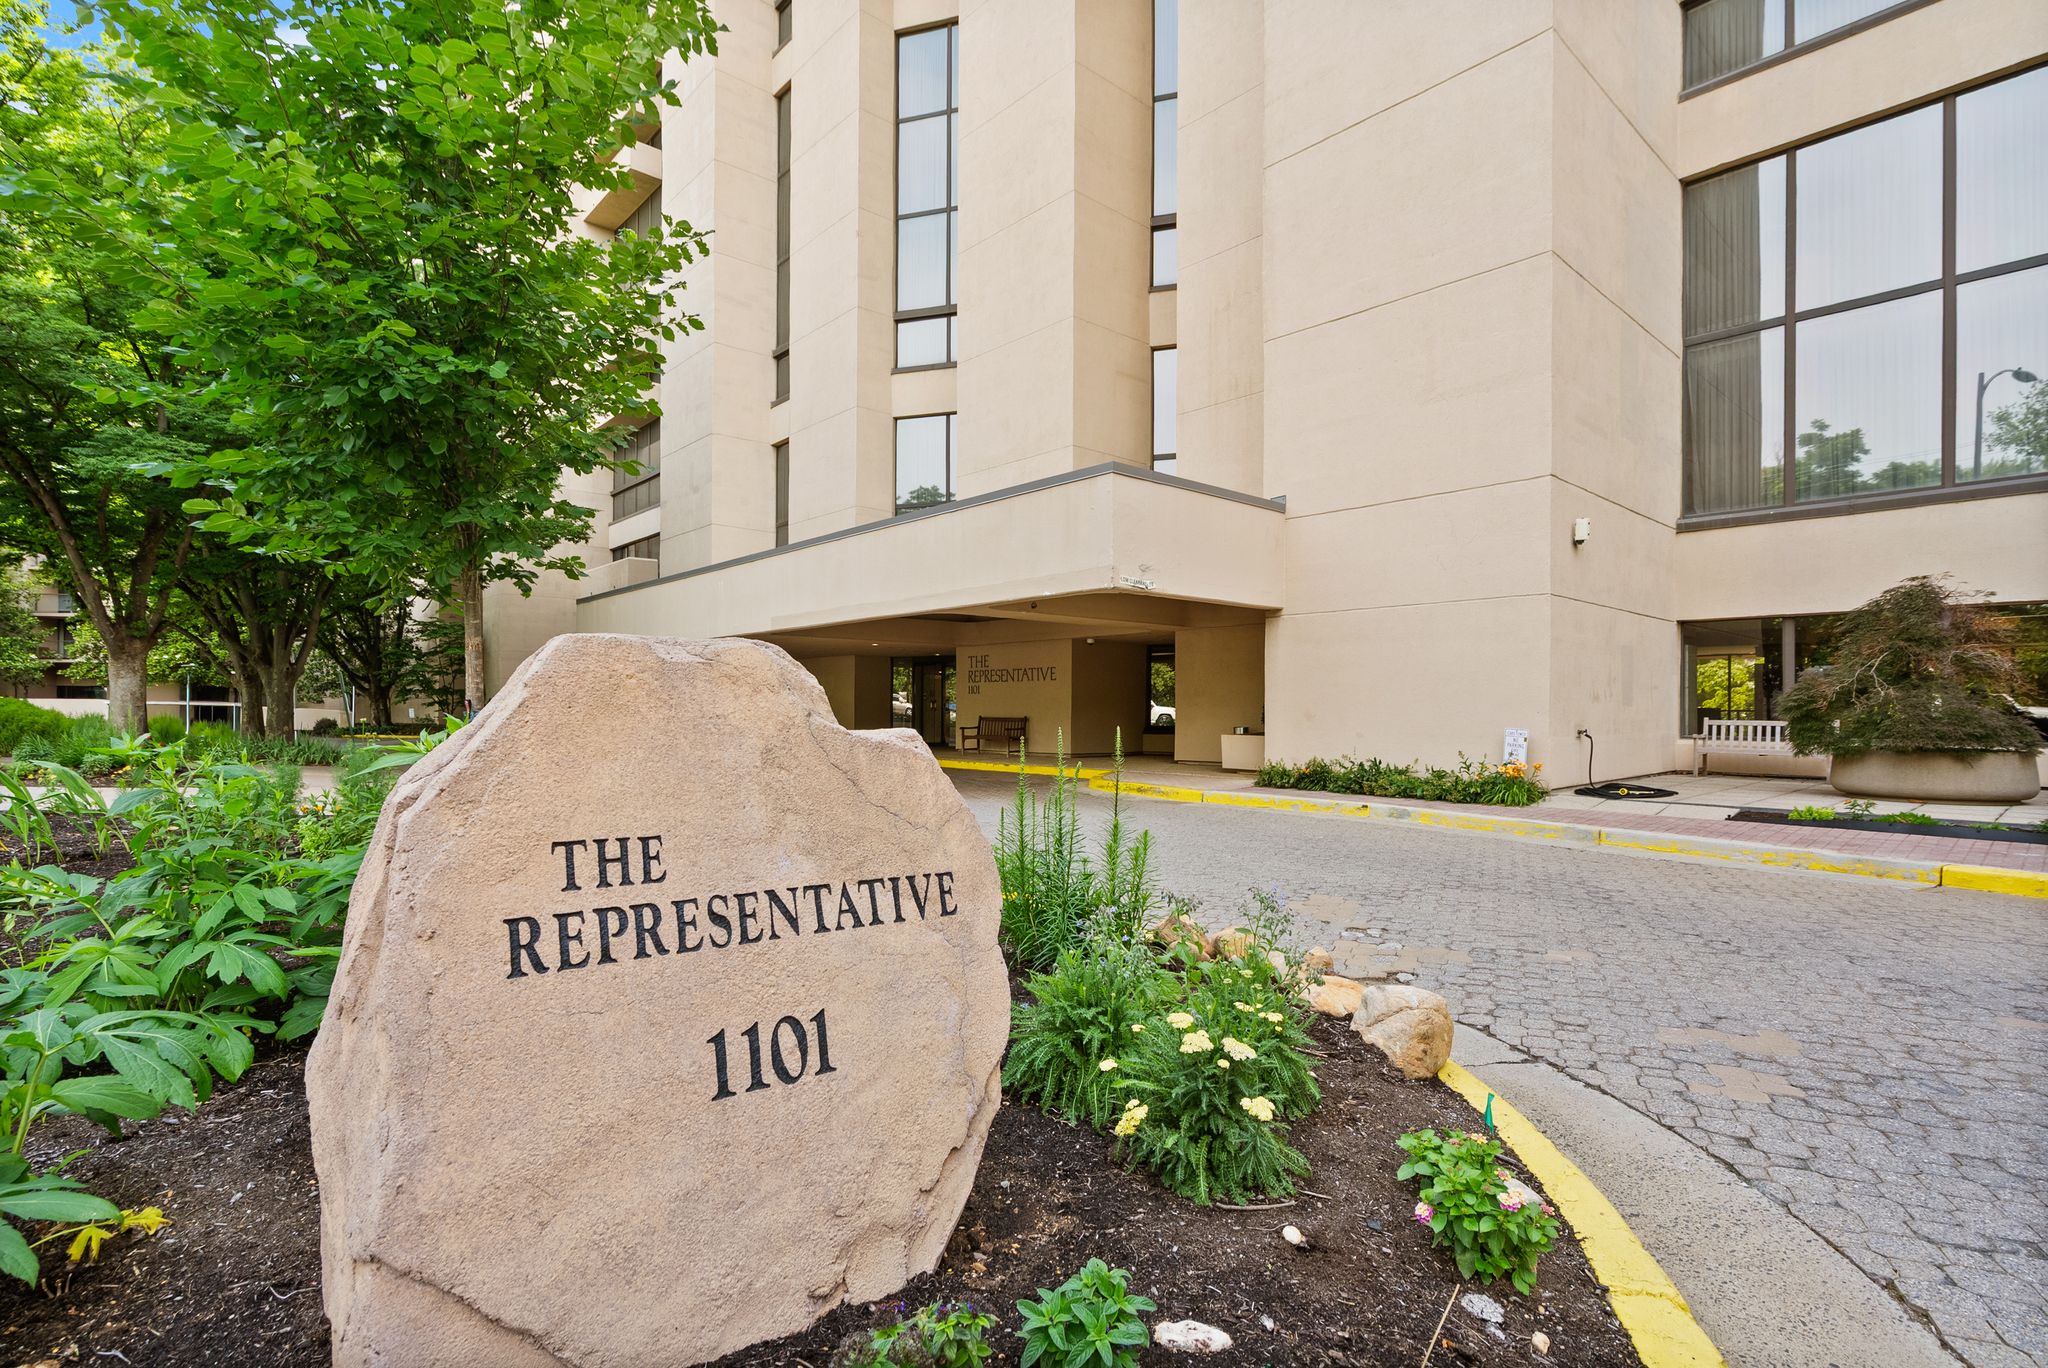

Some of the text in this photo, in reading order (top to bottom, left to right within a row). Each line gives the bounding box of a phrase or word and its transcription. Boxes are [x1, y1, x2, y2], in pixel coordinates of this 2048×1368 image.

[967, 654, 990, 669] THE
[967, 666, 1057, 684] REPRESENTATIVE
[967, 685, 981, 695] 1101
[550, 834, 667, 893] THE
[502, 871, 959, 980] REPRESENTATIVE
[705, 1007, 838, 1101] 1101
